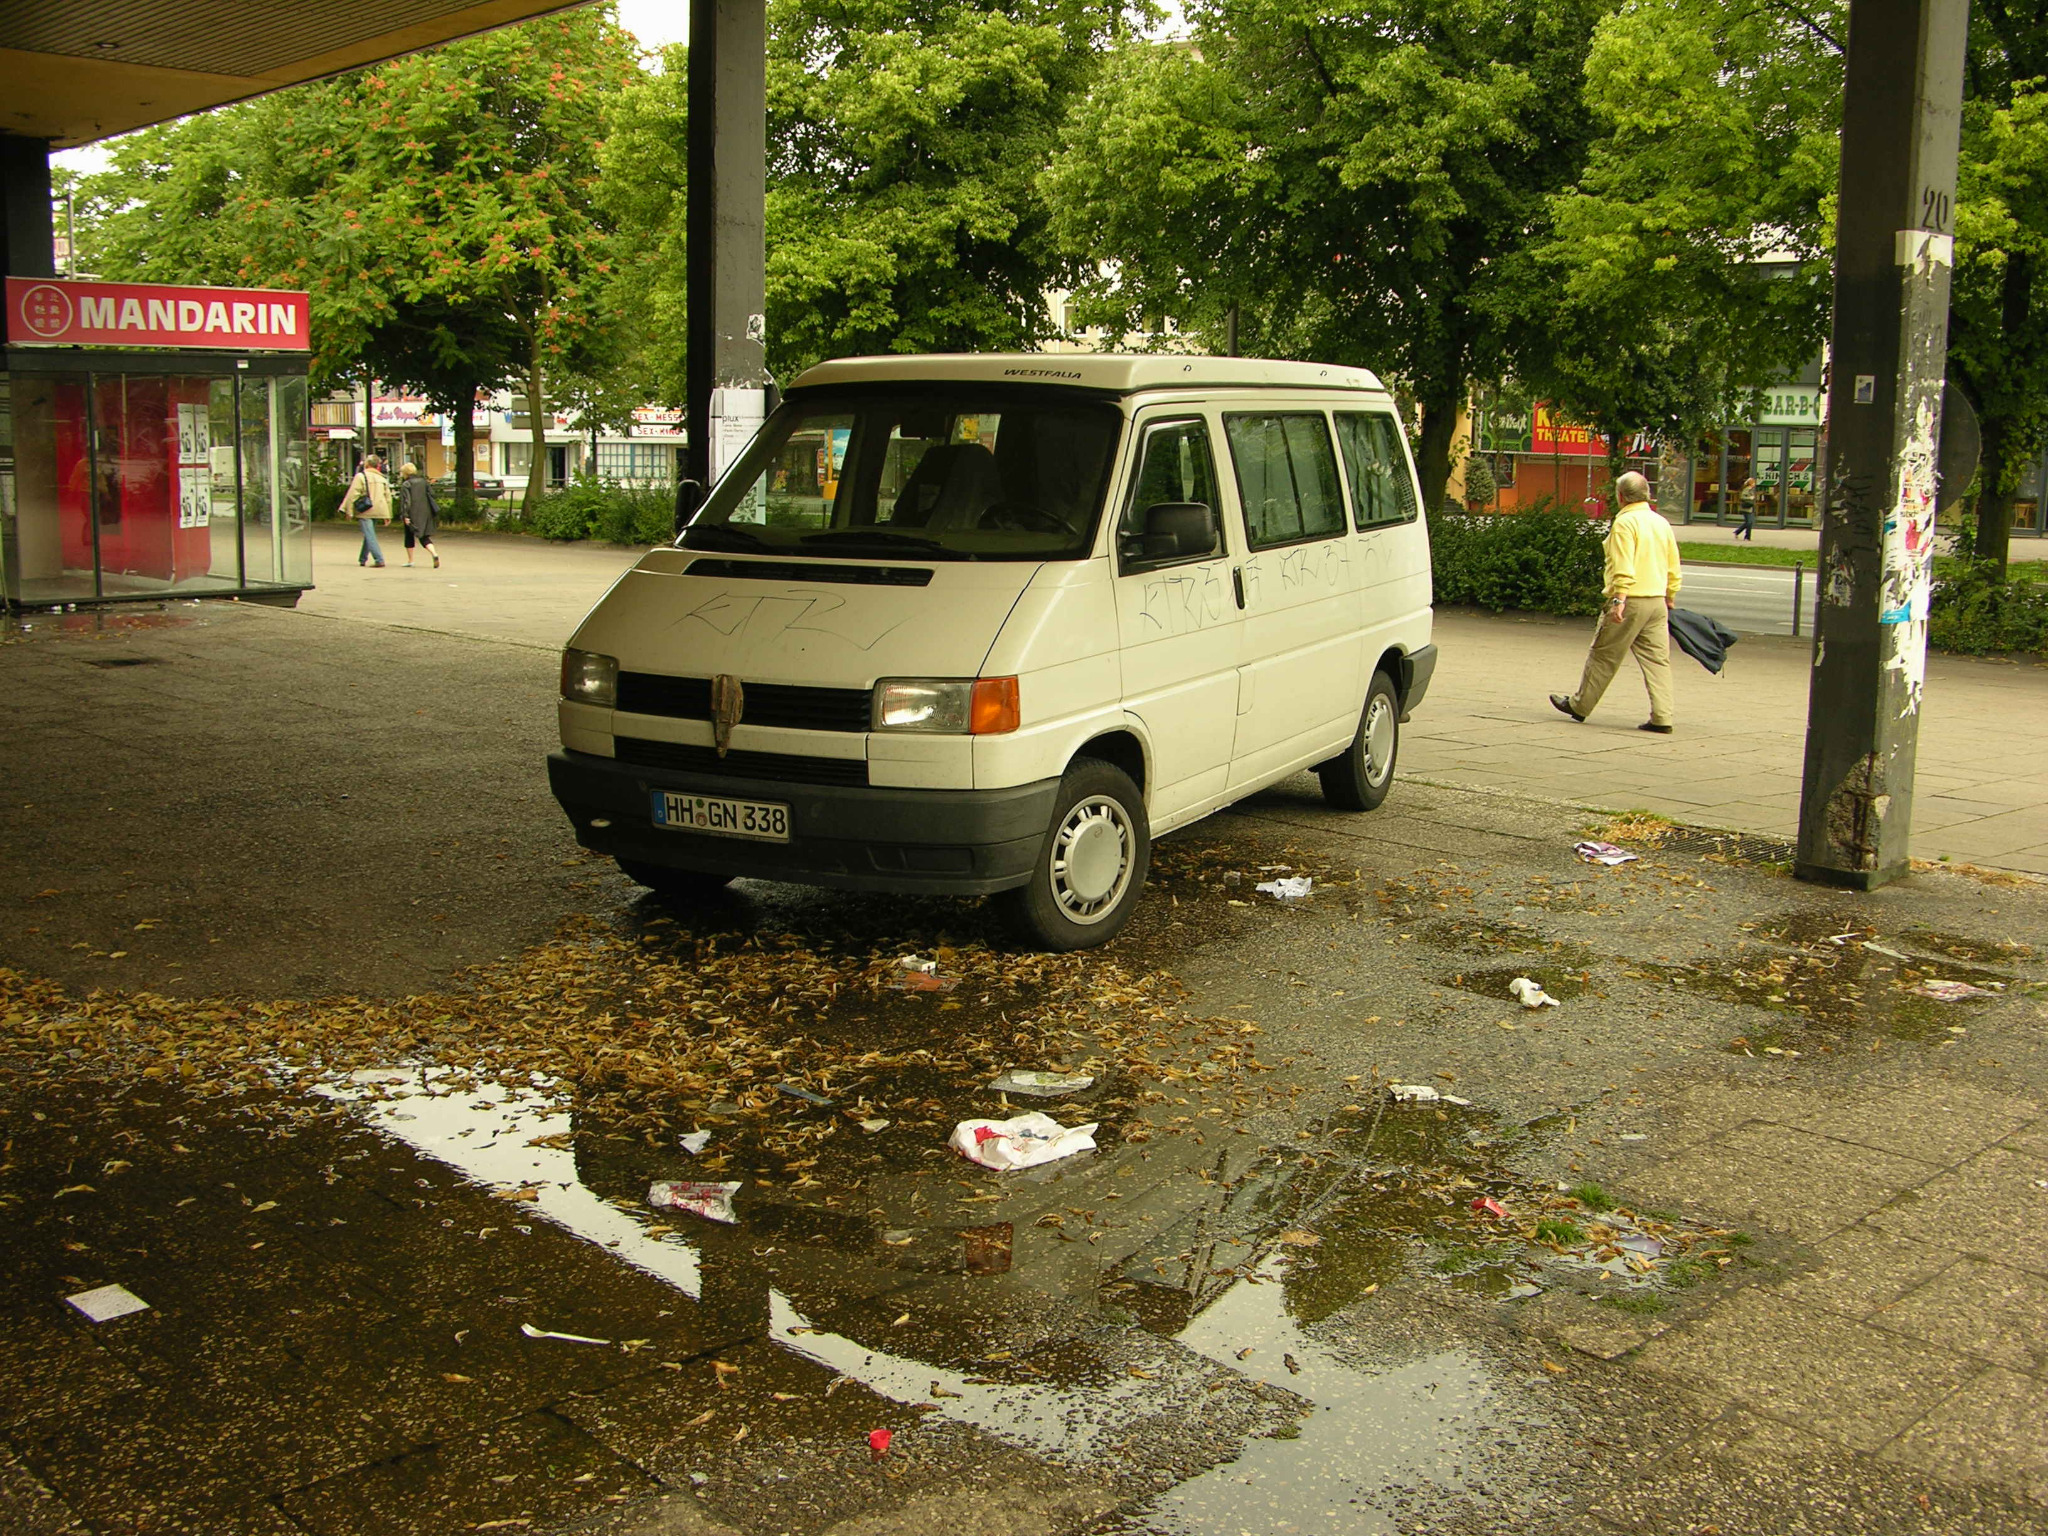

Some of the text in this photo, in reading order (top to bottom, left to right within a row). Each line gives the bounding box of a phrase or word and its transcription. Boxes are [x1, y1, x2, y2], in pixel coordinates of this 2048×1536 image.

[1922, 184, 1949, 231] 20
[80, 296, 297, 335] MANDARIN
[1004, 369, 1082, 379] WESTFALIA
[666, 796, 694, 824] HH
[708, 802, 738, 829] GN
[743, 805, 786, 834] 338
